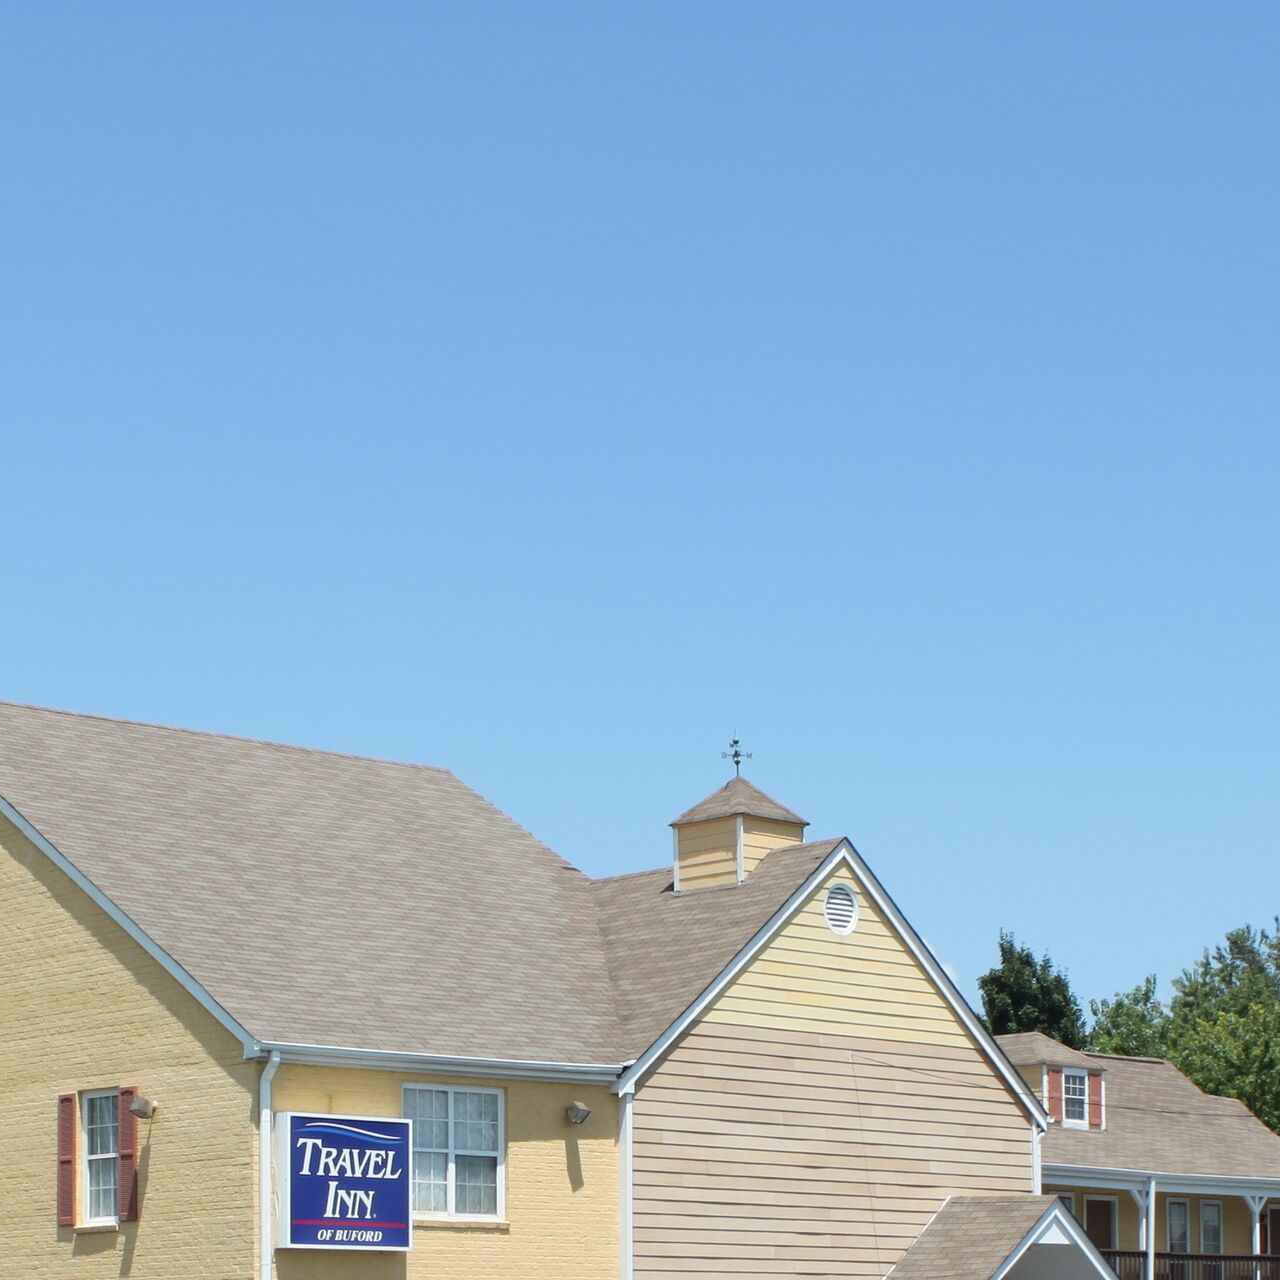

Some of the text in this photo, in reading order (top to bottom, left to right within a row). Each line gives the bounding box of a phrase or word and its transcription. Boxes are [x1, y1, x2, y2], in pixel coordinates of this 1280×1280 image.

[296, 1137, 402, 1179] TRAVEL
[322, 1180, 375, 1219] INN
[317, 1229, 383, 1242] OF BUFORD
